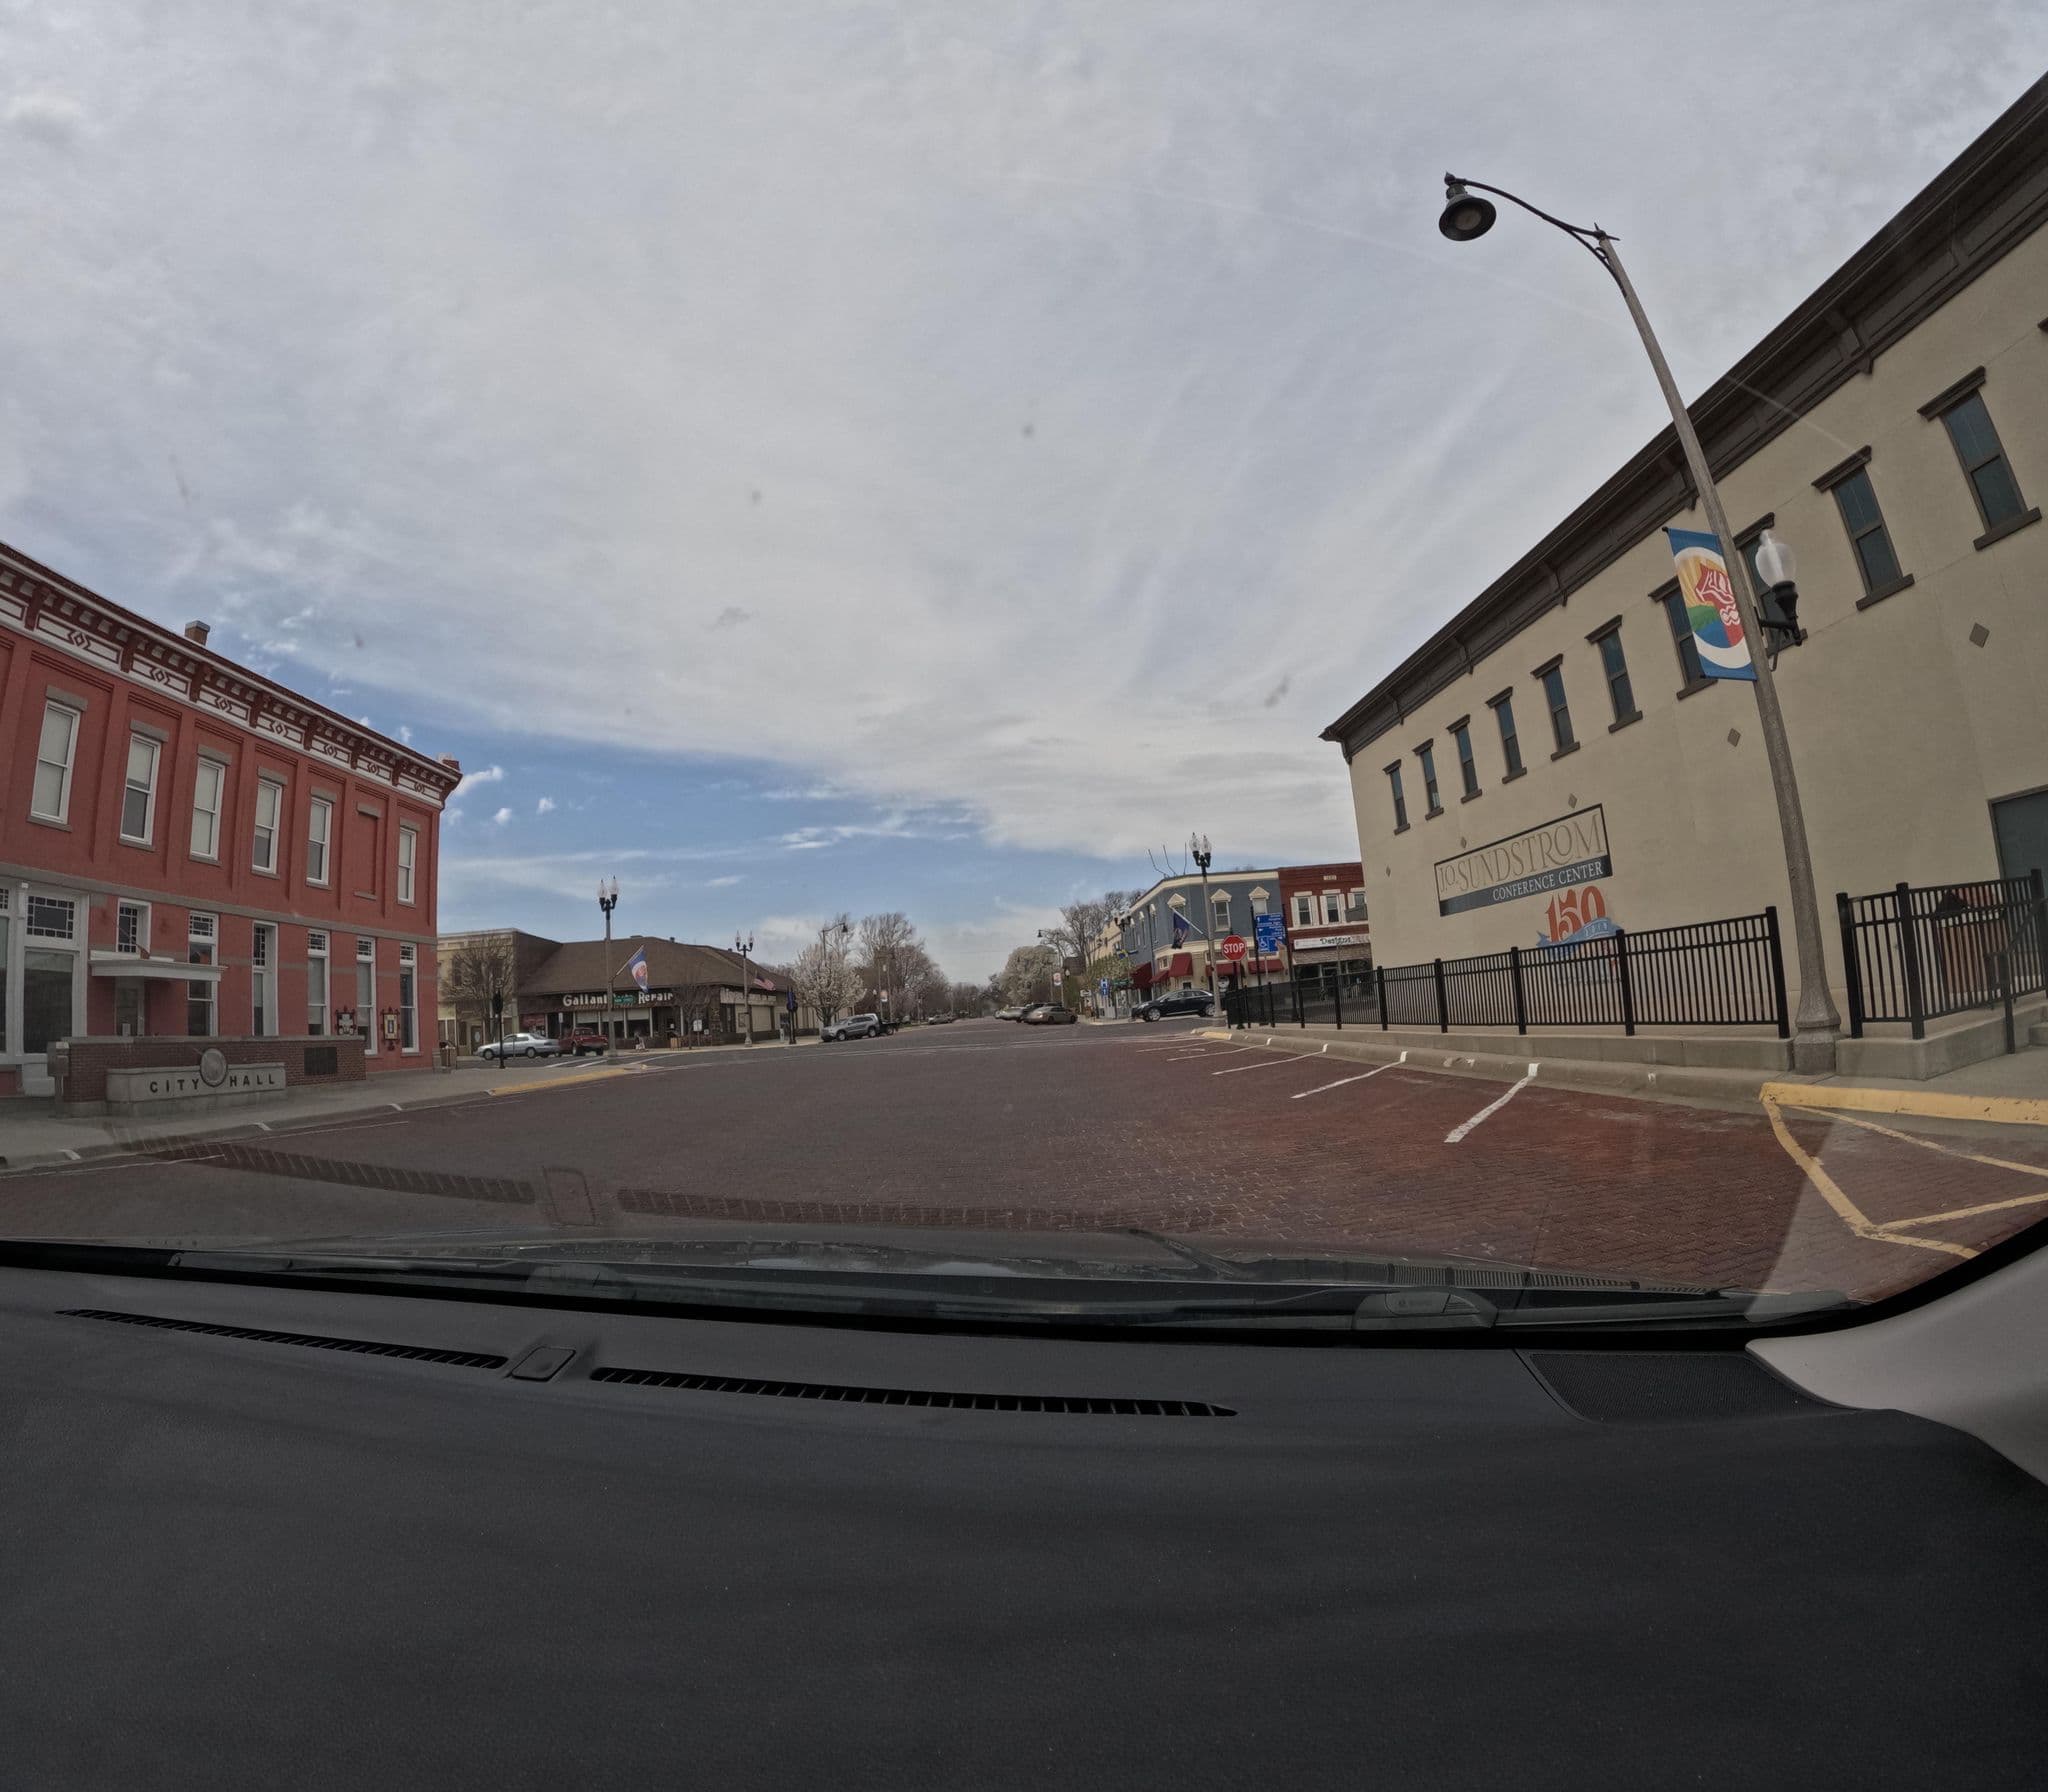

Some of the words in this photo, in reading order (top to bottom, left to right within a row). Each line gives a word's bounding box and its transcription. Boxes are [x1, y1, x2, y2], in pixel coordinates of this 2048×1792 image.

[1458, 813, 1604, 892] SUNDSTROM
[1492, 872, 1556, 902] CONFERENCE
[1558, 861, 1604, 886] CENTER
[1545, 886, 1607, 943] 150
[1222, 942, 1246, 955] STOP
[638, 991, 674, 1005] Repair
[149, 1079, 200, 1094] CITY
[229, 1073, 276, 1088] HALL
